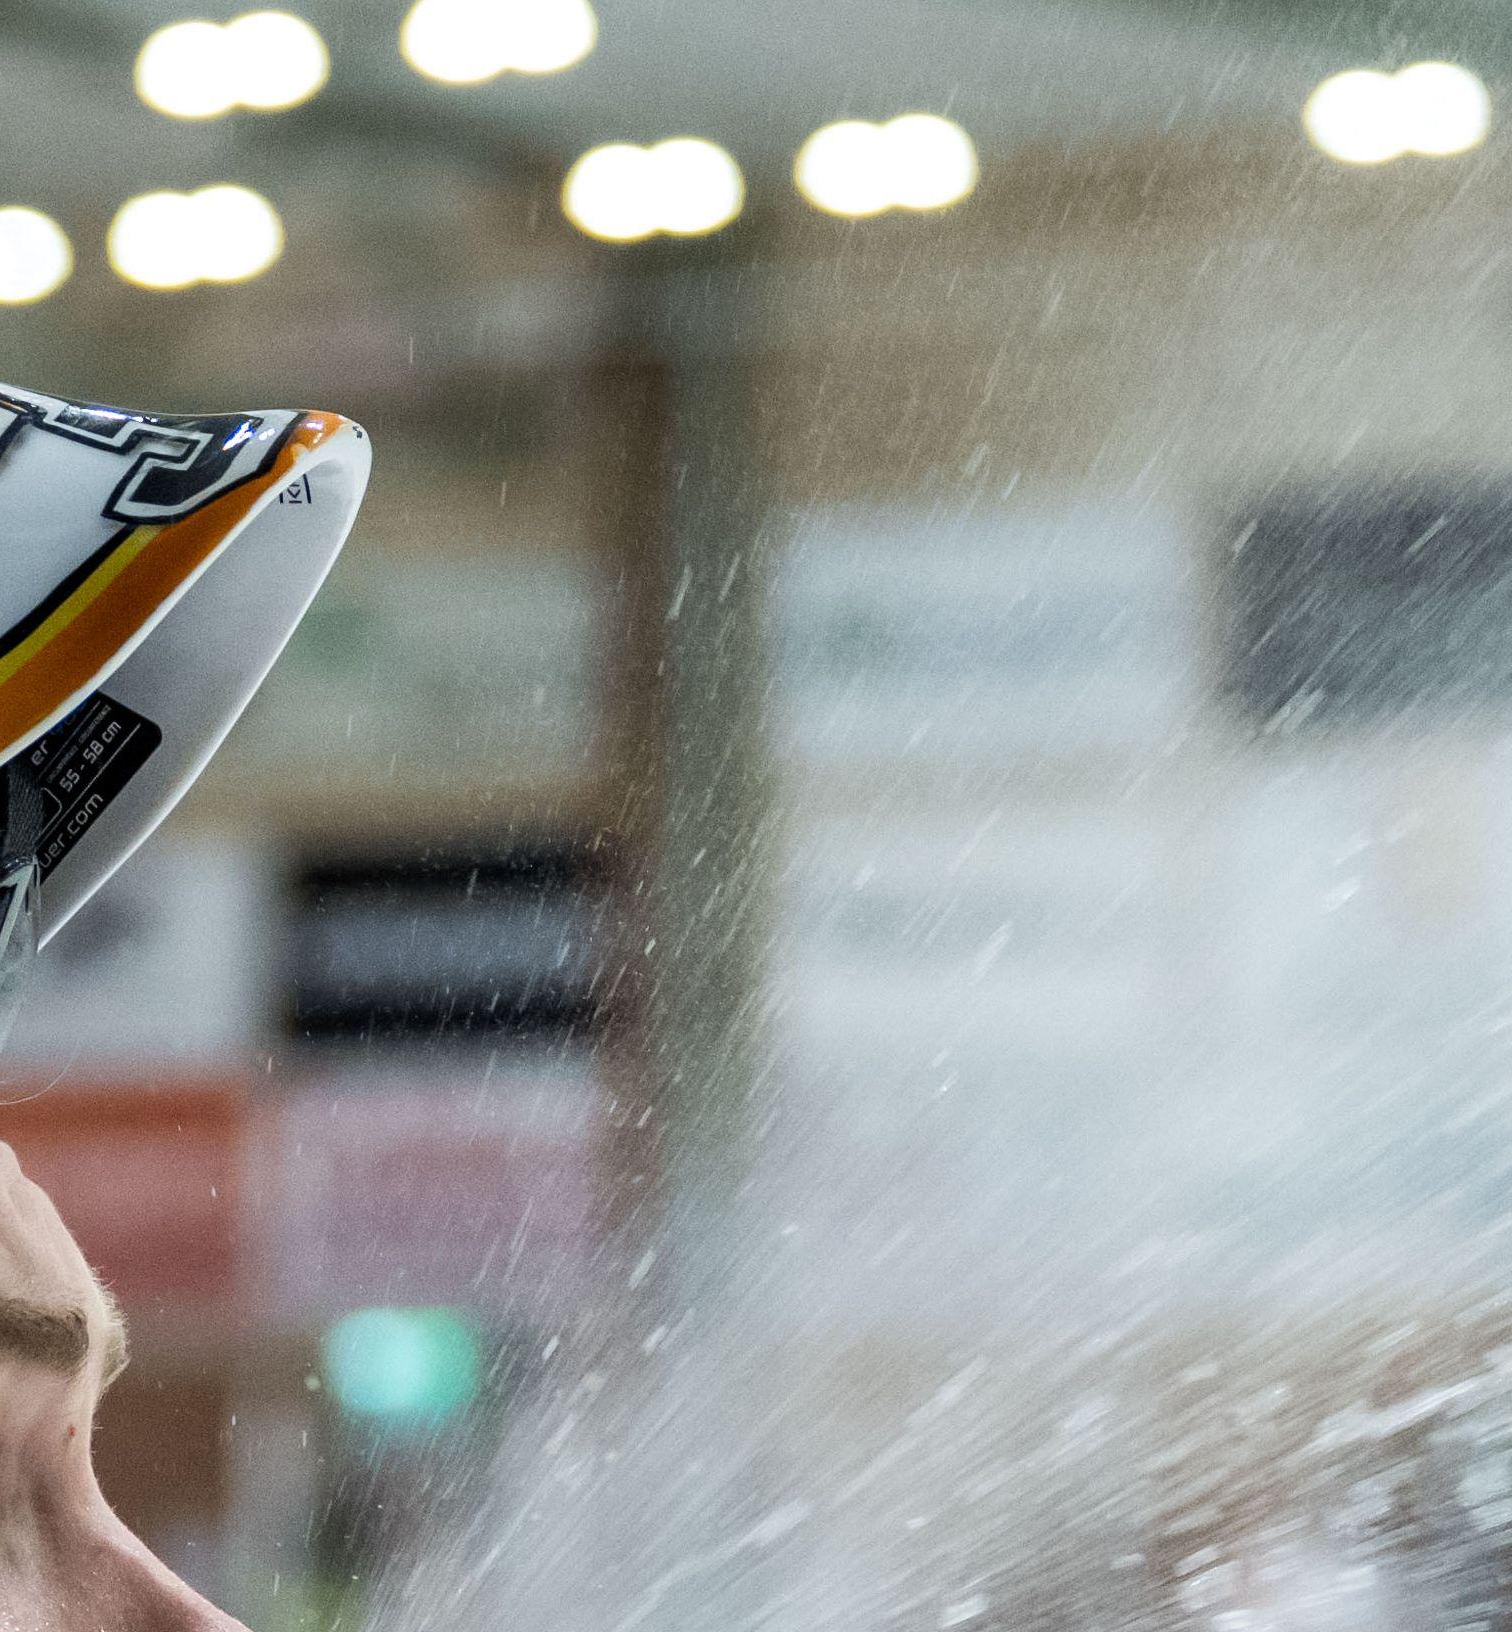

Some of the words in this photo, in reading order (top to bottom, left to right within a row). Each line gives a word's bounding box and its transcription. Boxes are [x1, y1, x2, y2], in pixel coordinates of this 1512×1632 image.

[59, 768, 80, 792] 55
[83, 739, 104, 765] 58
[101, 720, 122, 743] cm
[39, 793, 104, 868] uer.com
